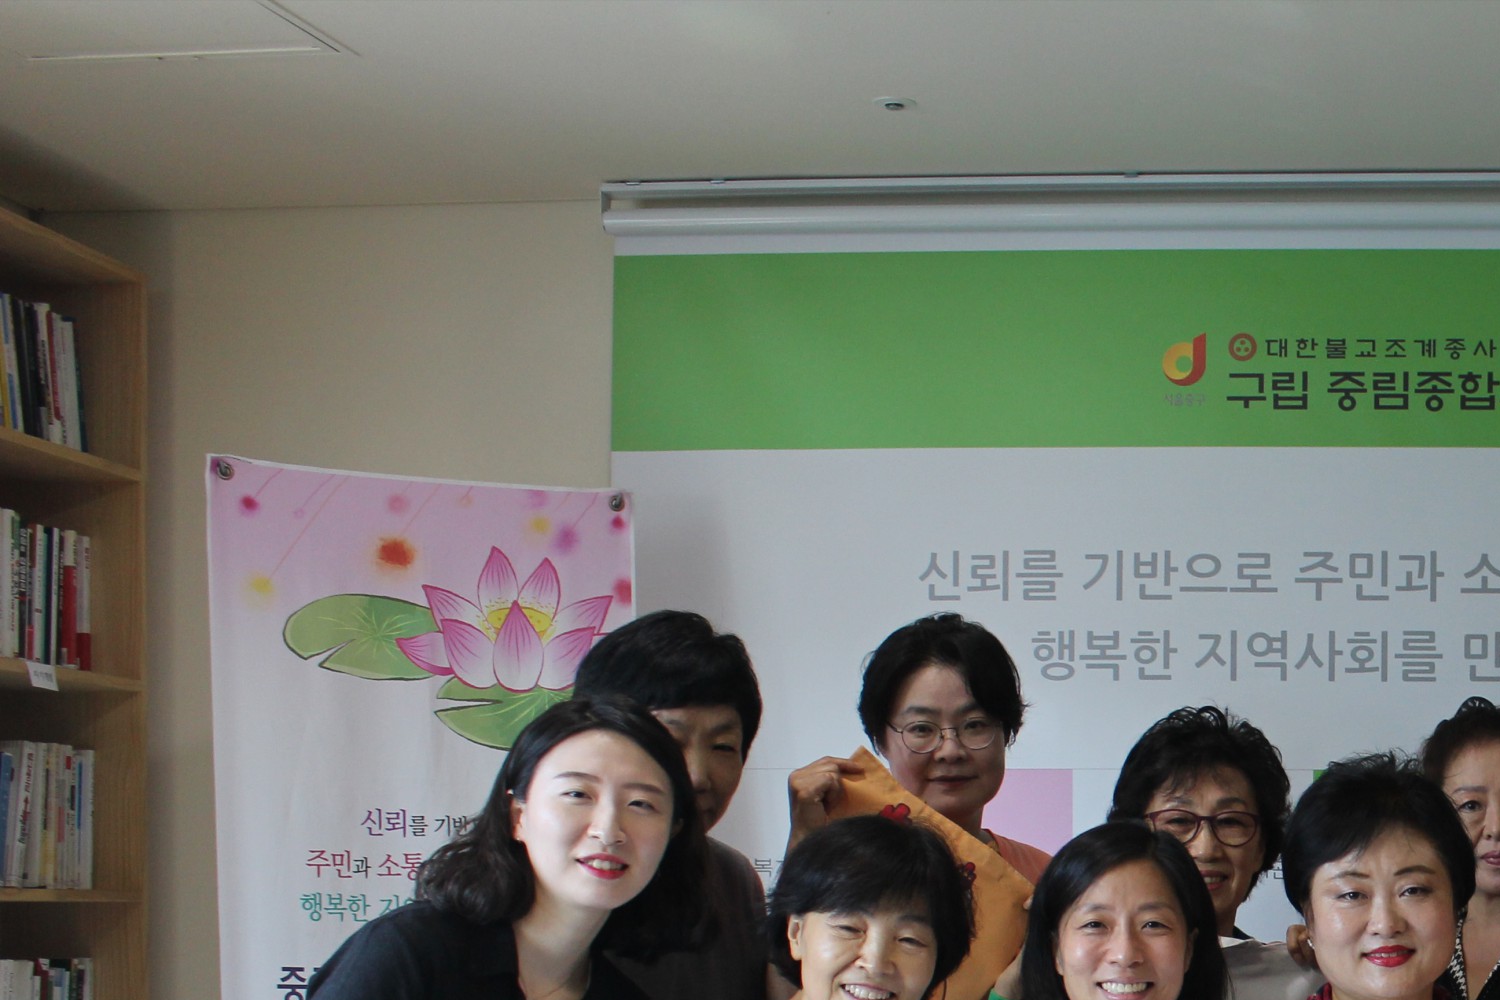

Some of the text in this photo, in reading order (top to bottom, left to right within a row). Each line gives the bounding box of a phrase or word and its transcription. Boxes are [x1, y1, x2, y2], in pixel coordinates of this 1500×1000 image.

[1226, 371, 1308, 410] 구립
[918, 550, 1064, 601] 신뢰를
[1082, 550, 1278, 601] 기반으로
[1294, 550, 1444, 602] 주민과
[1031, 630, 1178, 681] 행복한
[1195, 630, 1443, 682] 지역사회를
[360, 808, 468, 837] 신뢰를 기반
[305, 850, 424, 880] 주민과 소통
[300, 892, 371, 922] 행복한
